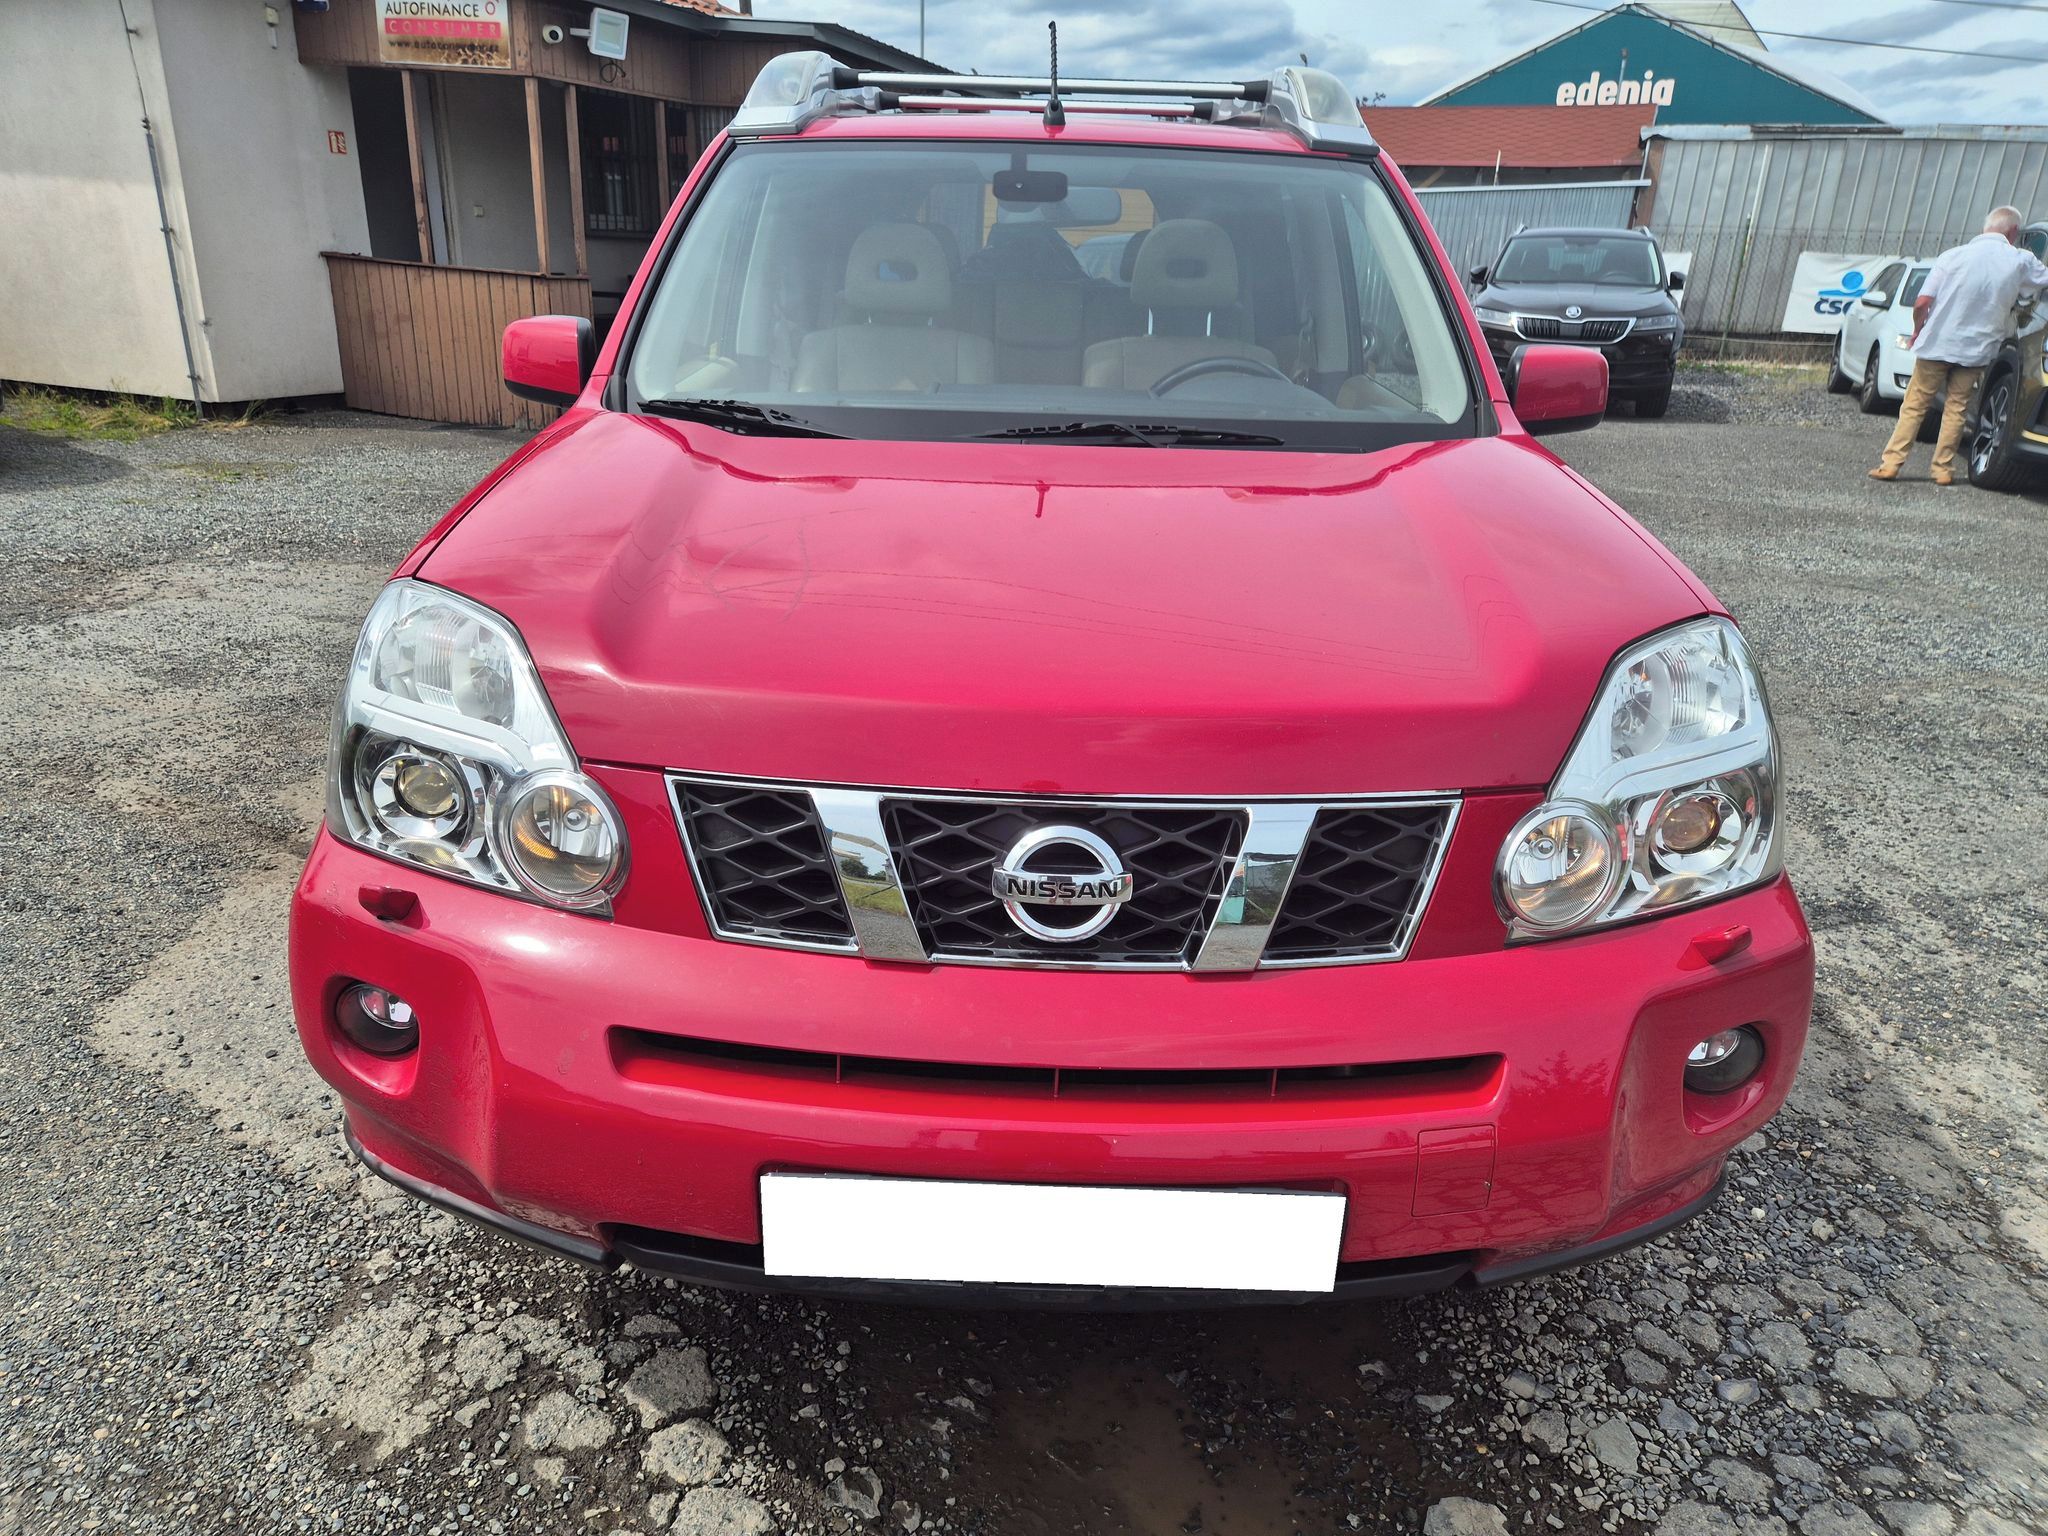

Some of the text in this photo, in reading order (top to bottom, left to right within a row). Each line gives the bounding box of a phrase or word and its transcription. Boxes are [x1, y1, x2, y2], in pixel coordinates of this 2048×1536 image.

[385, 1, 480, 18] AUTOFINANCE
[388, 20, 497, 36] CONSUMER
[1556, 70, 1675, 106] edenia
[1007, 878, 1118, 899] NISSAN
